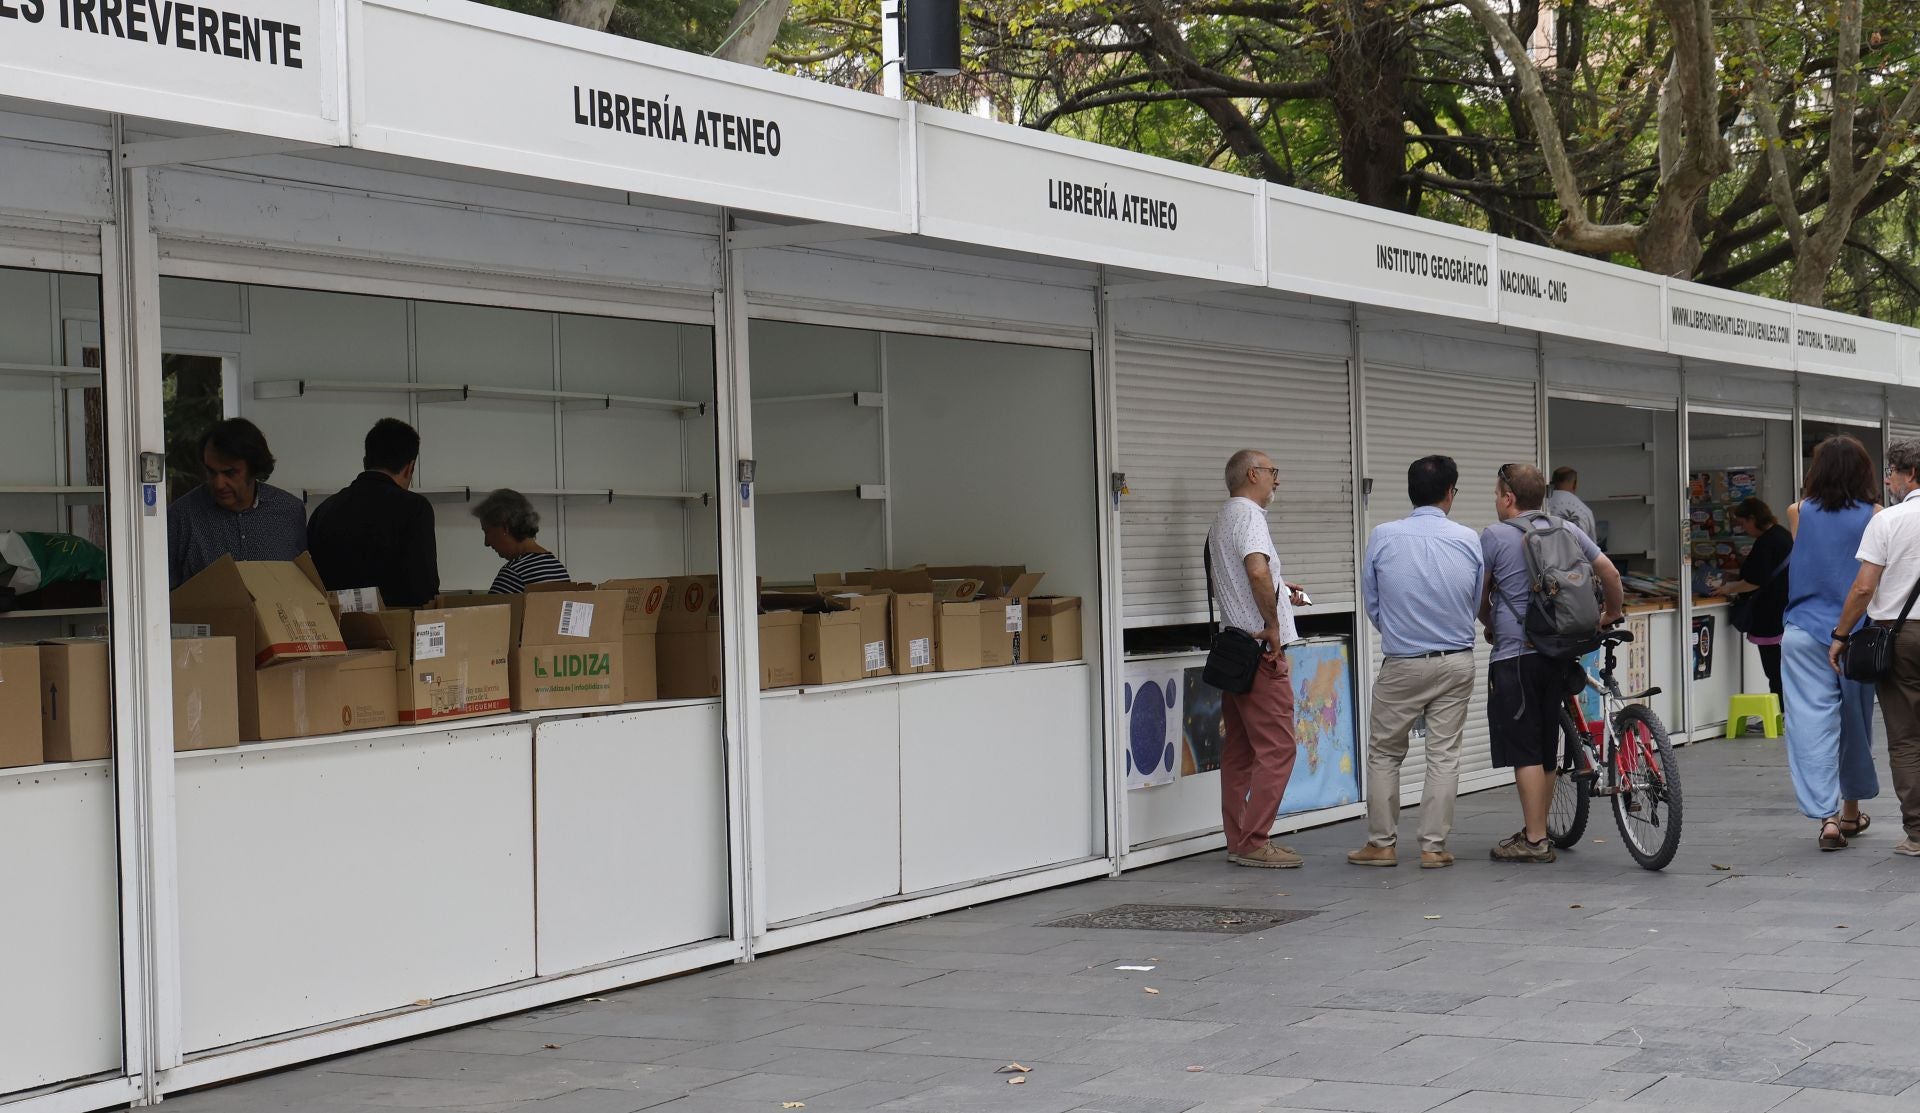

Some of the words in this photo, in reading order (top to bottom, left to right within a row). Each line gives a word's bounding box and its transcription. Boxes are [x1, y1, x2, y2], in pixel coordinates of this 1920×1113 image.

[59, 0, 303, 69] IRREVERENTE
[573, 85, 688, 143] LIBRERÍA
[694, 109, 781, 157] ATENEO
[1048, 178, 1119, 221] LIBRERÍA
[1121, 193, 1178, 231] ATENEO
[1376, 244, 1429, 277] INSTITUTO
[1430, 255, 1488, 287] GEOGRÁFICO
[1499, 268, 1542, 299] NACIONAL
[1548, 279, 1568, 304] CNIG
[1671, 306, 1790, 344] WWW.LIBROSINFANTILESYJUVENILES.COM
[1797, 329, 1824, 350] EDITORIAL
[1824, 333, 1857, 355] TRAMUNTANA
[553, 653, 610, 678] LIDIZA
